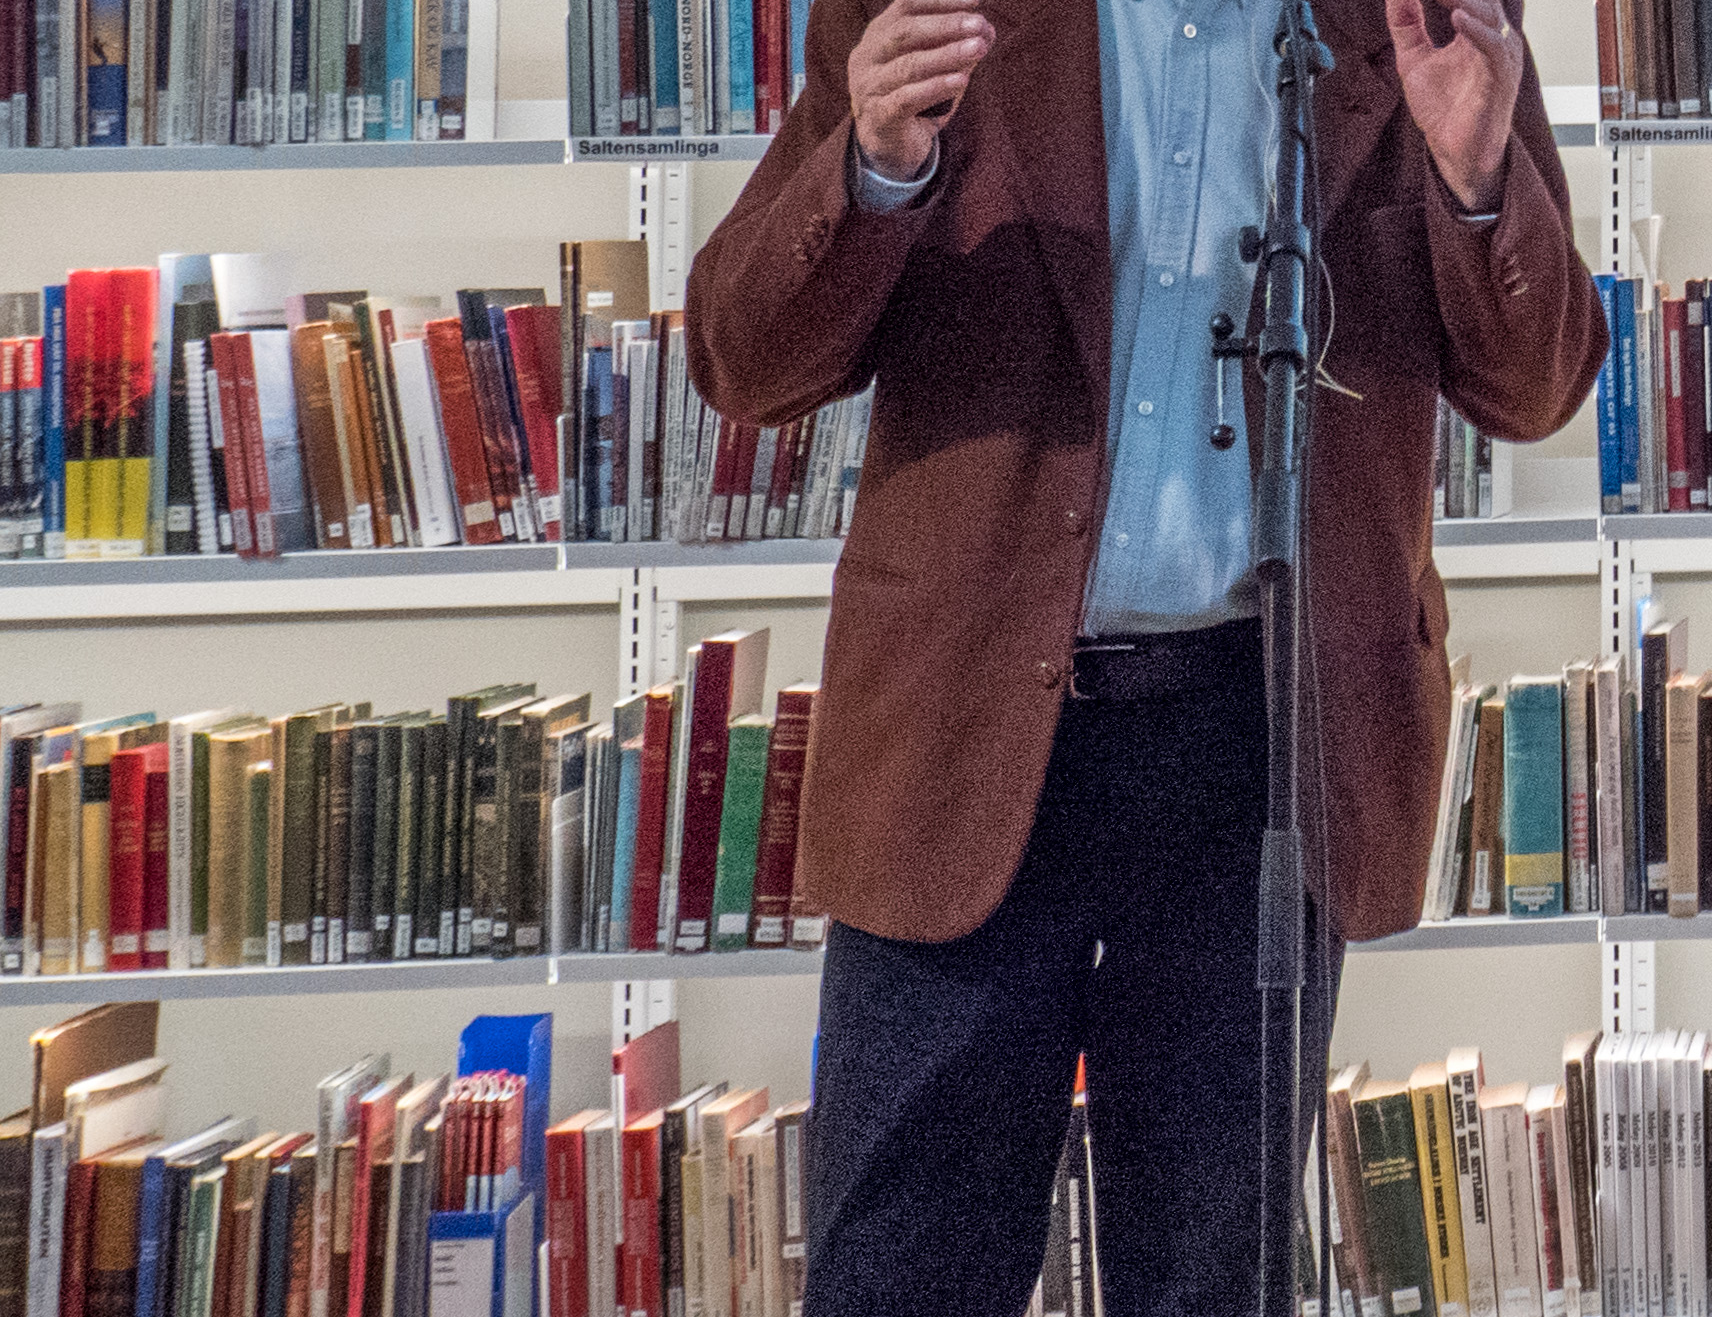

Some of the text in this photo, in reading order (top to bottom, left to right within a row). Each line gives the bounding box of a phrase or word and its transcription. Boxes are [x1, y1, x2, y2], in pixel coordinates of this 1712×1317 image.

[578, 139, 720, 156] Saltensamlinga
[1464, 1075, 1485, 1224] THE IRON AGE SETTLEMENT
